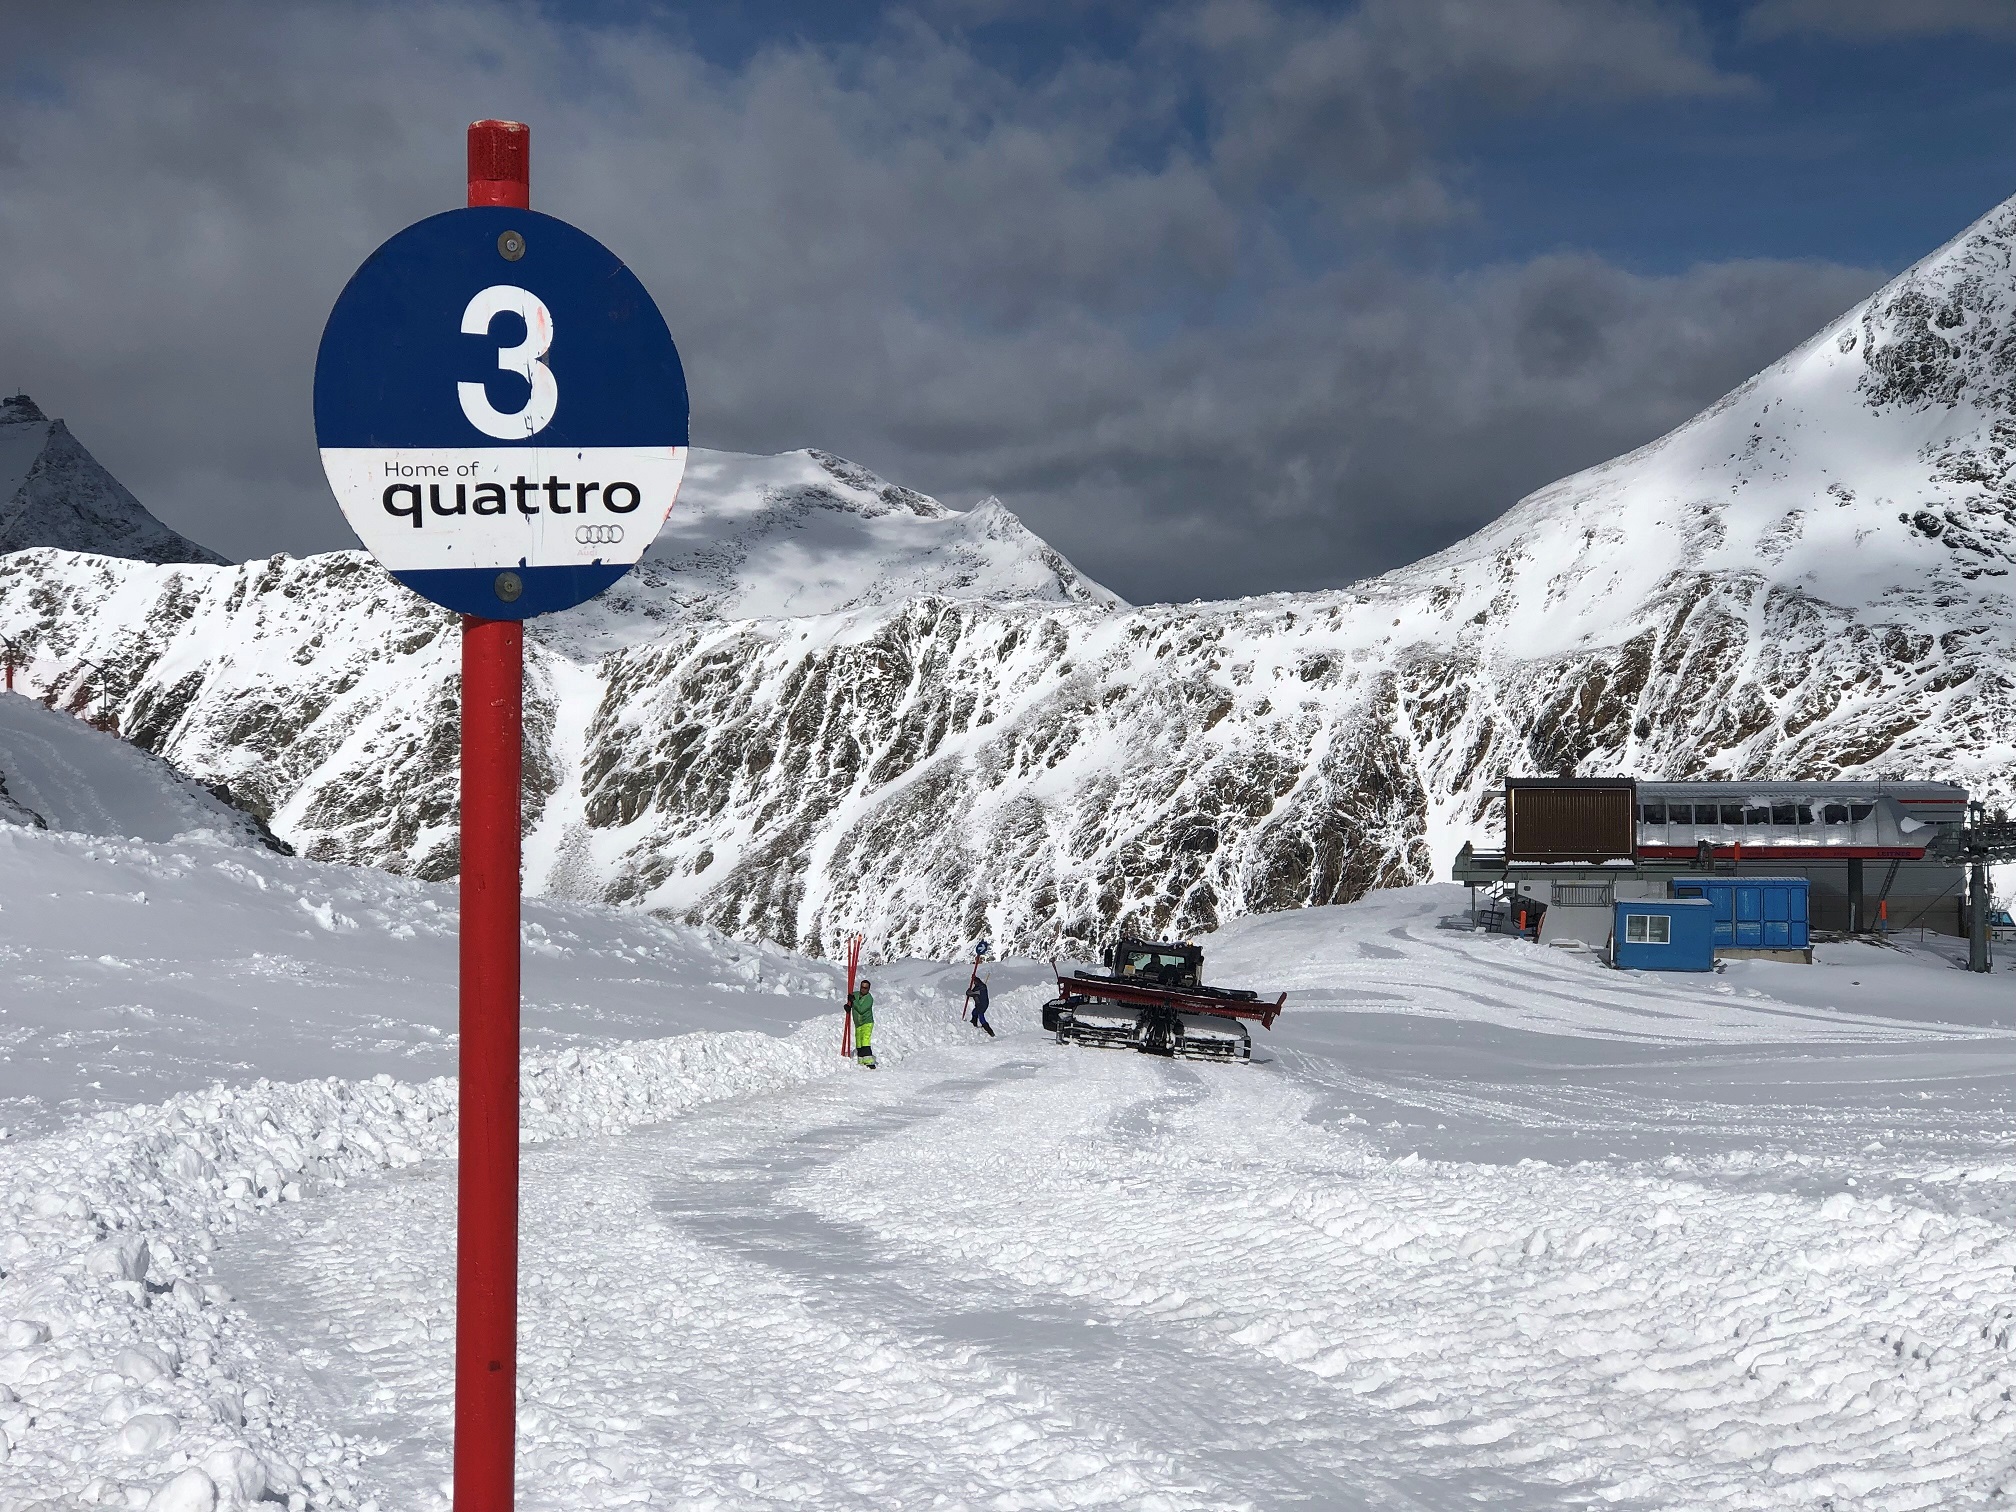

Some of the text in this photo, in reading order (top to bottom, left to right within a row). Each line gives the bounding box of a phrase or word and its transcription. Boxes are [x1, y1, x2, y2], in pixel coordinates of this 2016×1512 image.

[457, 284, 558, 440] 3
[384, 461, 480, 477] Home of
[382, 475, 641, 529] quattro
[576, 548, 598, 557] Audi
